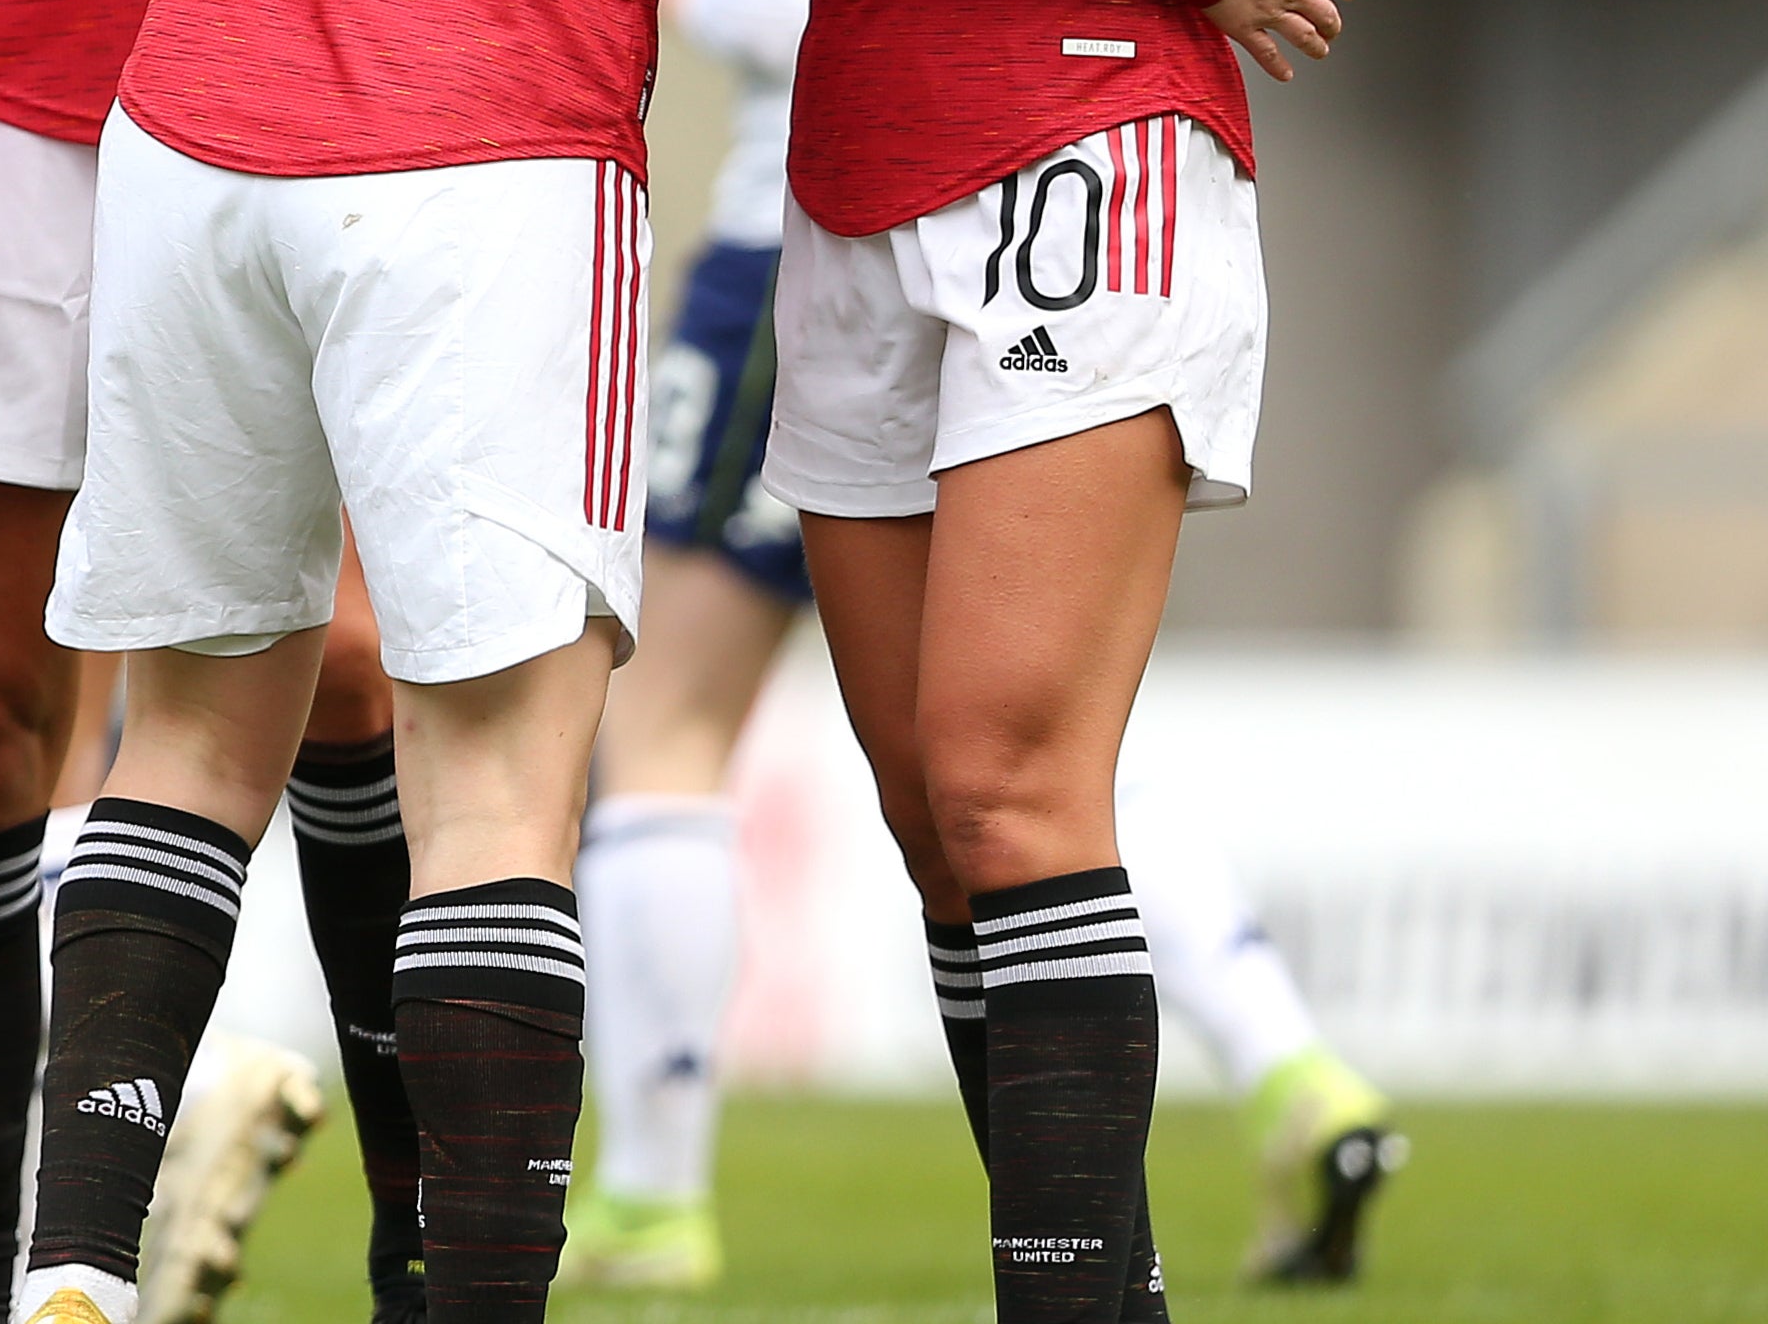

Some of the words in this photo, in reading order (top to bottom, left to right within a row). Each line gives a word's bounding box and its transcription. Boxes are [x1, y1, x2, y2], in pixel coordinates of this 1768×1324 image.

[981, 158, 1104, 313] 10
[998, 354, 1069, 373] adidas
[77, 1098, 166, 1138] adidas
[992, 1237, 1104, 1250] MANCHESTER
[1012, 1250, 1076, 1263] UNITED
